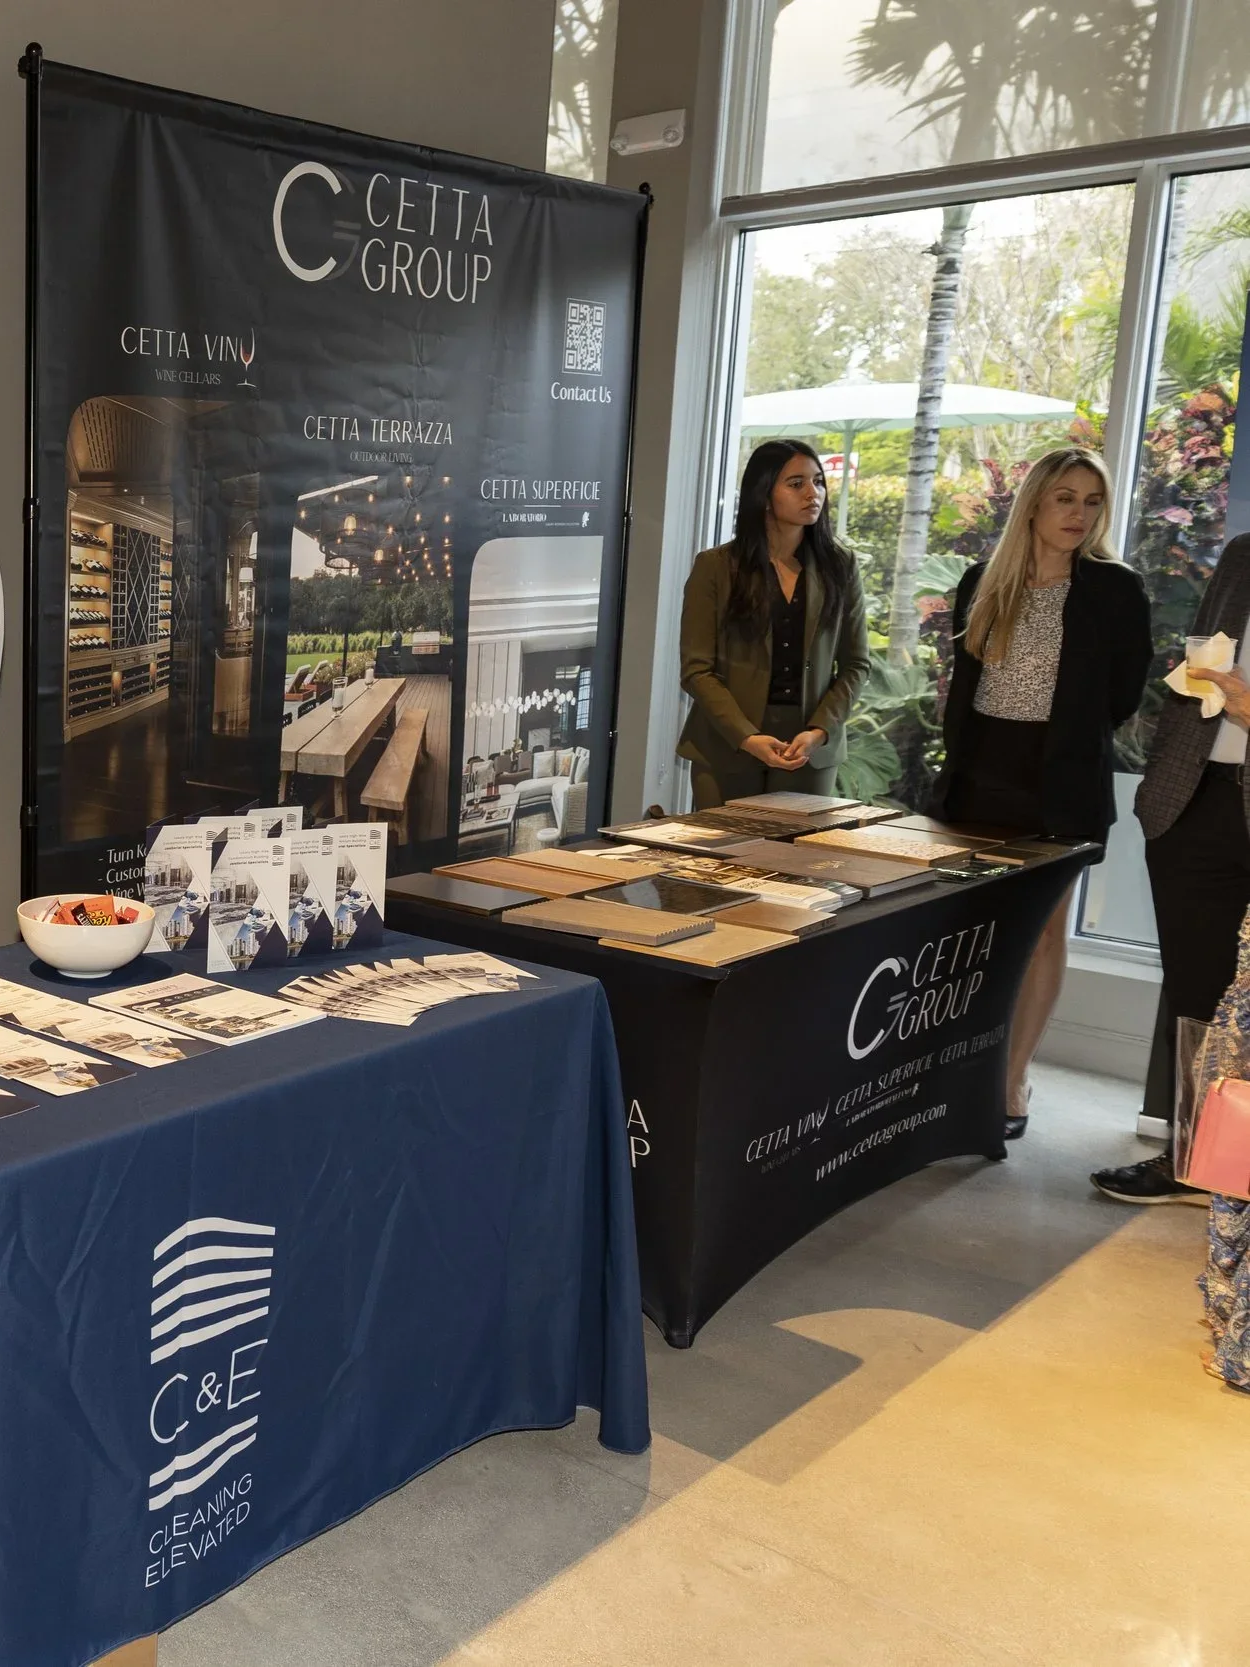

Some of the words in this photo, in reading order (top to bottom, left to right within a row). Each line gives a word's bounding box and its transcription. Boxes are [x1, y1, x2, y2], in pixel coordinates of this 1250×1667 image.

[366, 173, 493, 246] CETTA
[360, 238, 492, 304] GROUP
[121, 326, 190, 359] CETTA
[155, 368, 178, 382] WINE
[178, 371, 221, 385] CELLARS
[550, 381, 597, 402] Contact
[599, 385, 612, 404] Us
[303, 415, 360, 441] CETTA
[371, 418, 453, 445] TERRAZZA
[350, 451, 387, 463] OUTDOOR
[388, 452, 414, 464] LIVING
[480, 479, 527, 500] CETTA
[532, 480, 601, 500] SUPERFICIE
[107, 848, 134, 863] Turn
[912, 919, 996, 988] CETTA
[898, 970, 983, 1041] GROUP
[939, 1040, 969, 1066] CETTA
[835, 1081, 872, 1115] CETTA
[876, 1052, 935, 1093] SUPERFICIE
[746, 1125, 790, 1163] CETTA
[816, 1103, 948, 1181] www.cettagroup.com
[148, 1473, 253, 1554] CLEANING
[145, 1501, 251, 1588] ELEVATED
